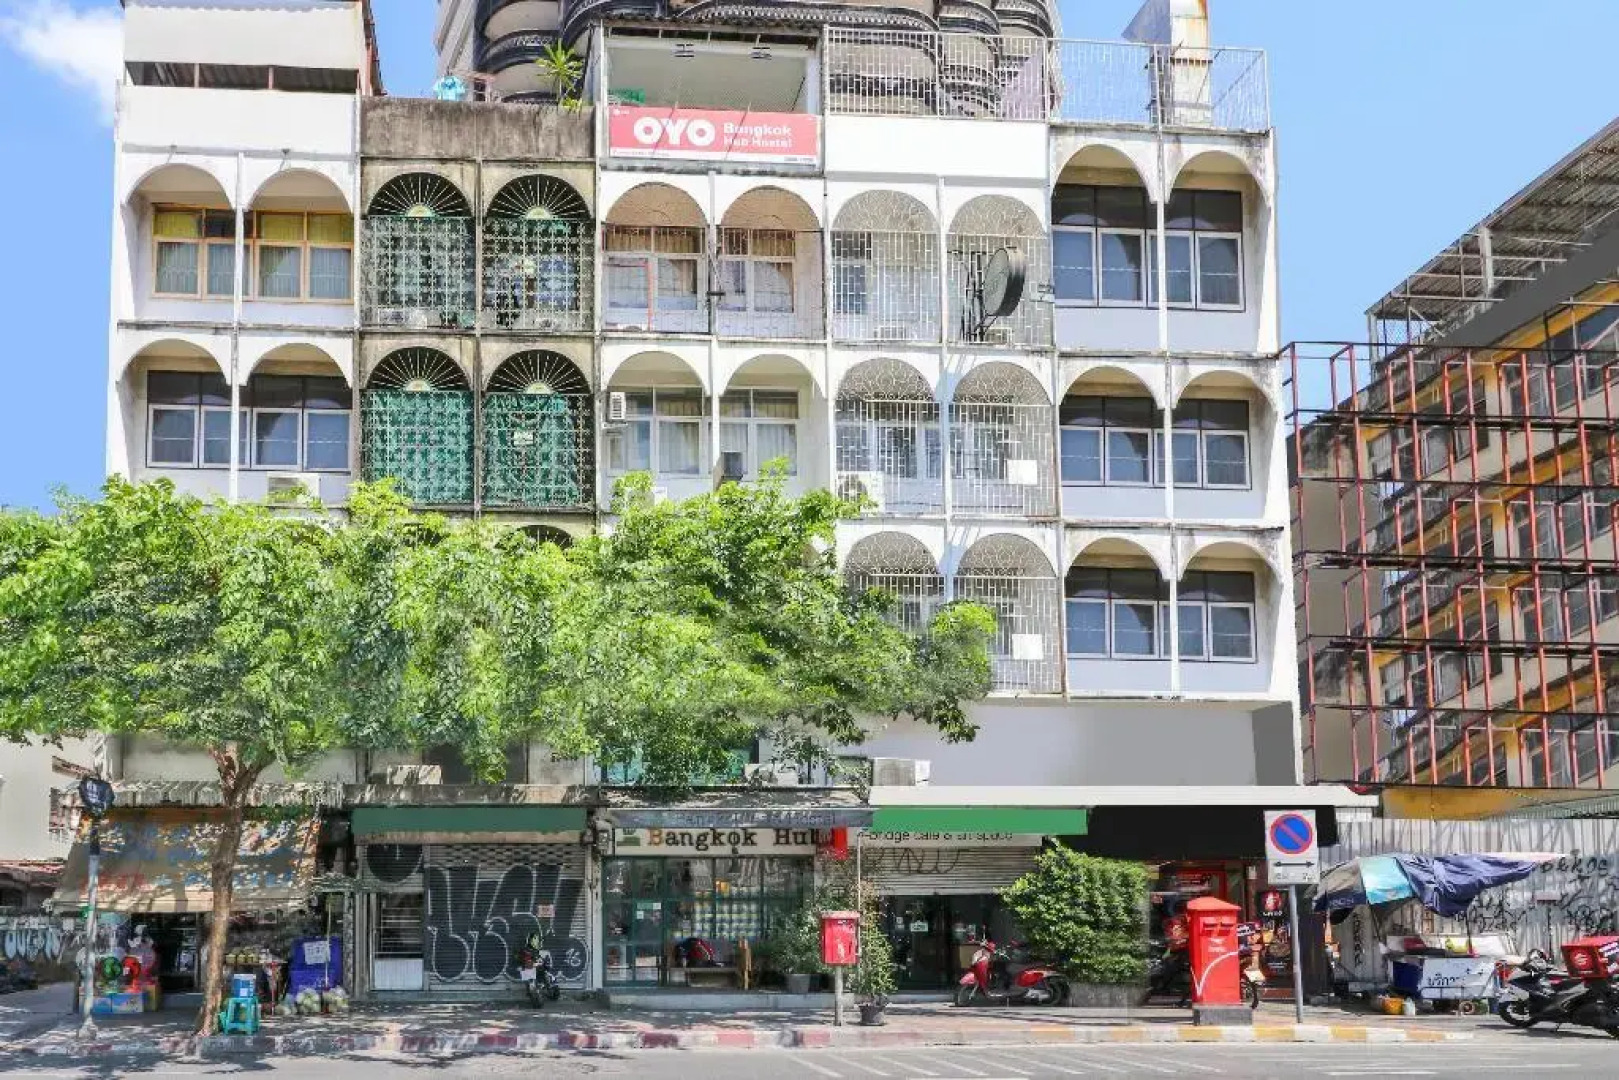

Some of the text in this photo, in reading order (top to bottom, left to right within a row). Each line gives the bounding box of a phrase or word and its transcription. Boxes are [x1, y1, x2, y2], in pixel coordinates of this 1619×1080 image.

[633, 116, 715, 147] OYO
[723, 121, 792, 137] Bangkok
[723, 137, 792, 149] Hub Hostel
[647, 827, 757, 851] Bangkok
